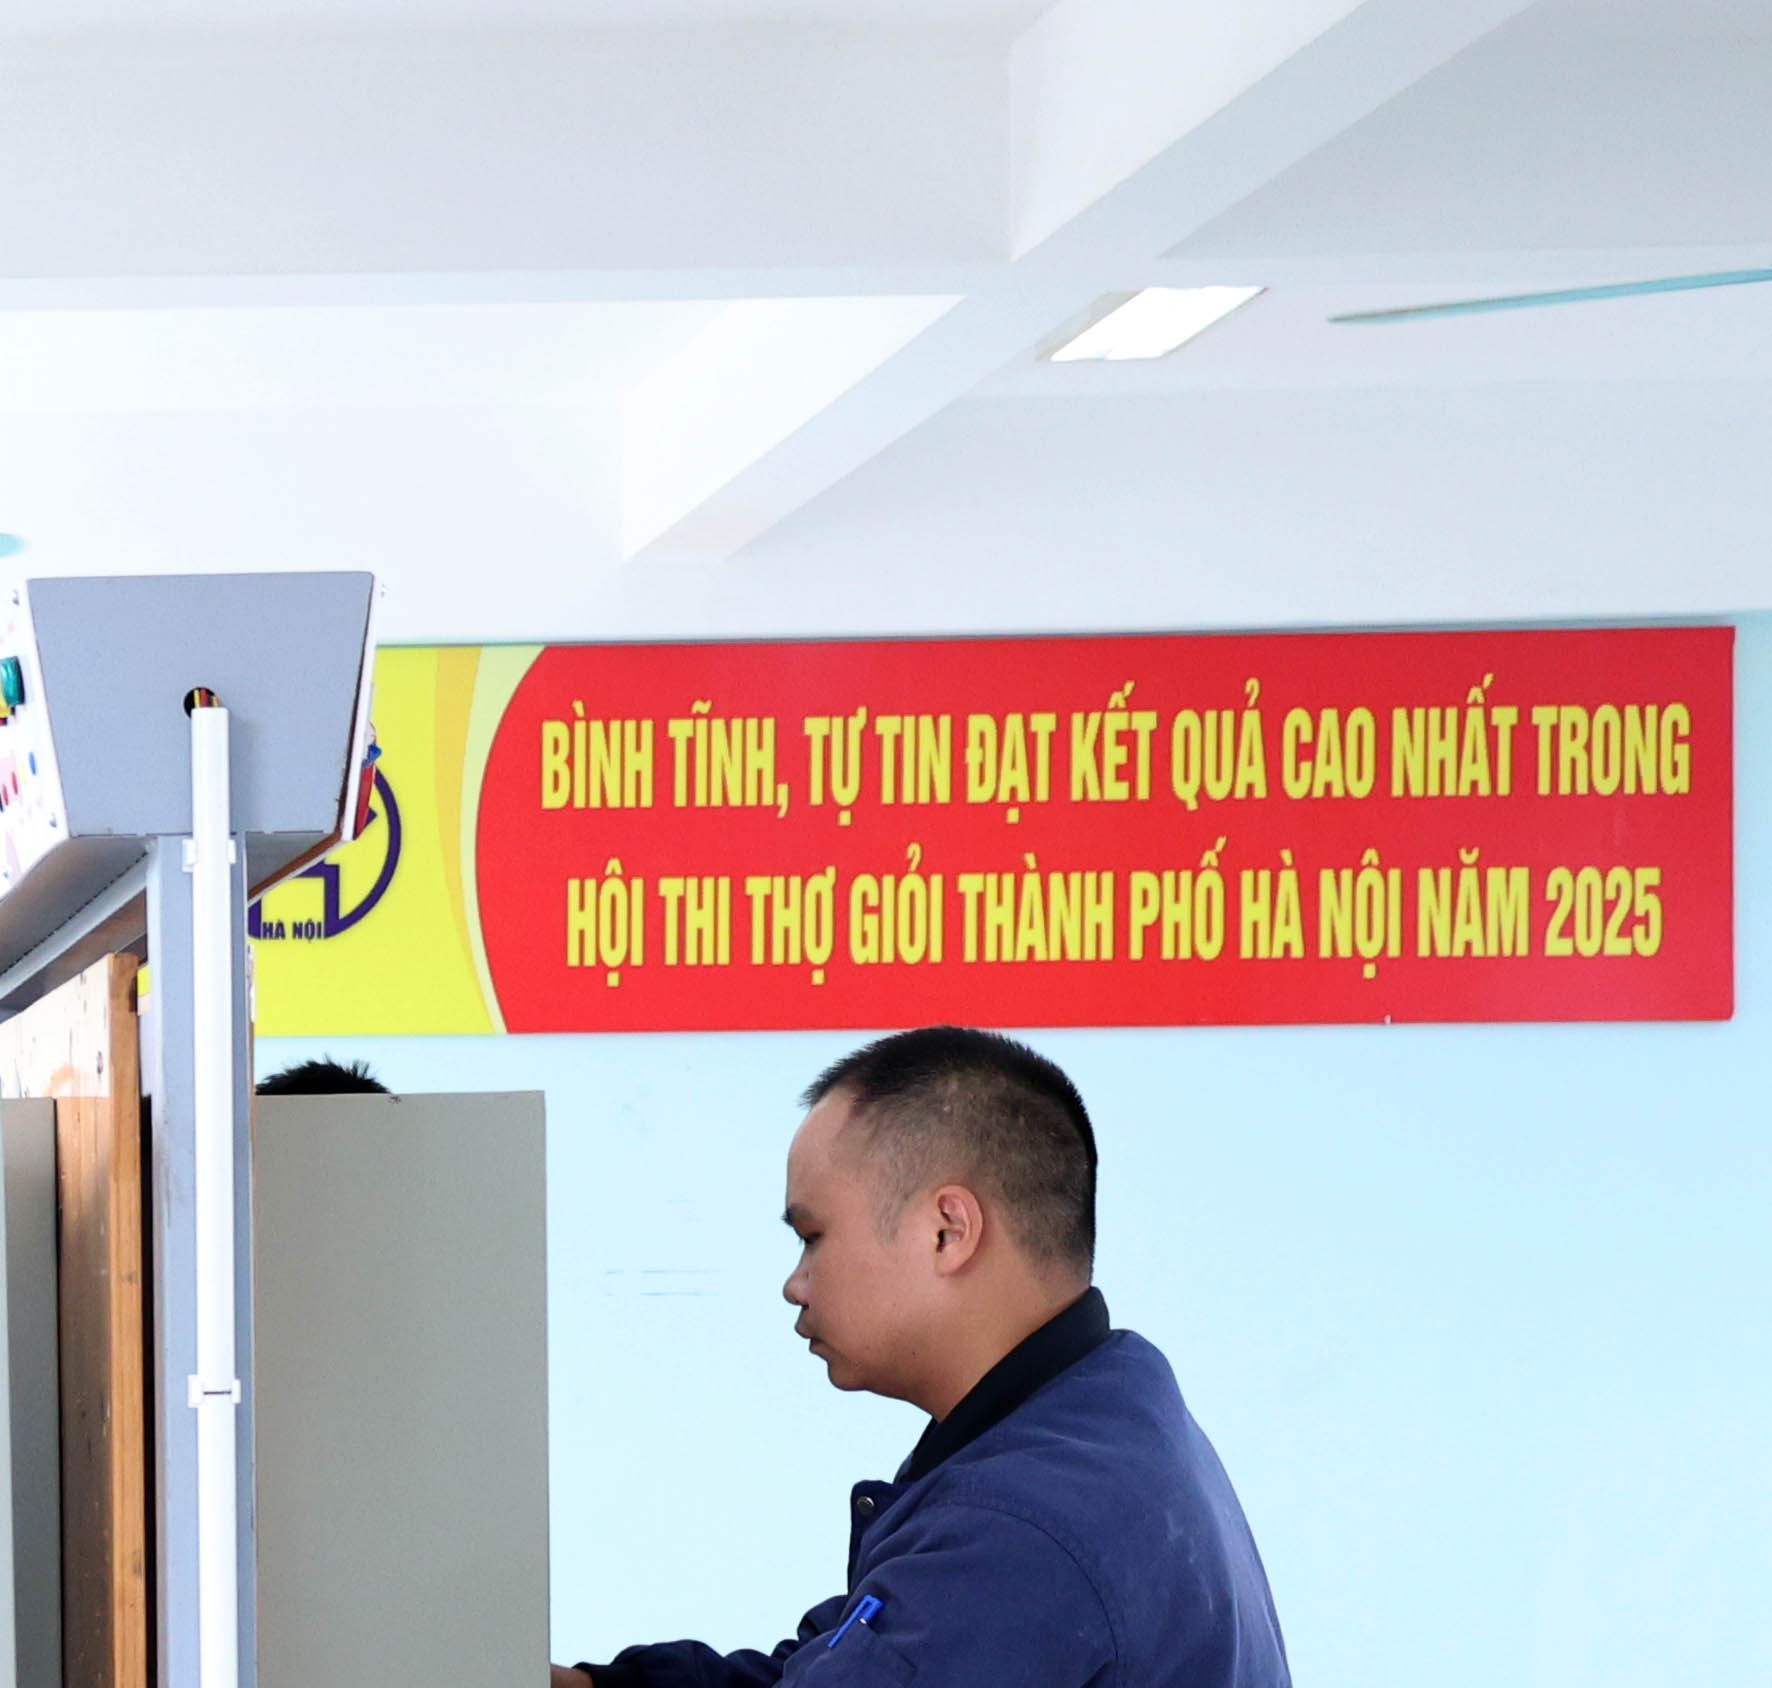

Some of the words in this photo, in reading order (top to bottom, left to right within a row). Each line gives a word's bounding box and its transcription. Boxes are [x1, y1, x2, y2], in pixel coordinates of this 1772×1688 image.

[541, 700, 654, 809] BÌNH
[668, 699, 789, 818] TĨNH,
[804, 705, 867, 826] TỰ
[875, 714, 952, 805] TIN
[965, 712, 1057, 824] ĐẠT
[1071, 681, 1158, 802] KẾT
[1171, 677, 1268, 811] QUẢ
[1282, 706, 1376, 800] CAO
[1391, 673, 1519, 798] NHẤT
[1531, 703, 1691, 796] TRONG
[262, 919, 286, 940] HÀ
[292, 918, 322, 943] NỘI
[566, 857, 645, 987] HỘI
[658, 876, 731, 966] THI
[745, 865, 837, 986] THỢ
[849, 842, 944, 965] GIỎI
[957, 852, 1115, 963] THÀNH
[1129, 836, 1227, 961] PHỐ
[1239, 848, 1305, 960] HÀ
[1318, 848, 1402, 980] NỘI
[1417, 847, 1530, 958] NĂM
[1544, 866, 1663, 958] 2025
